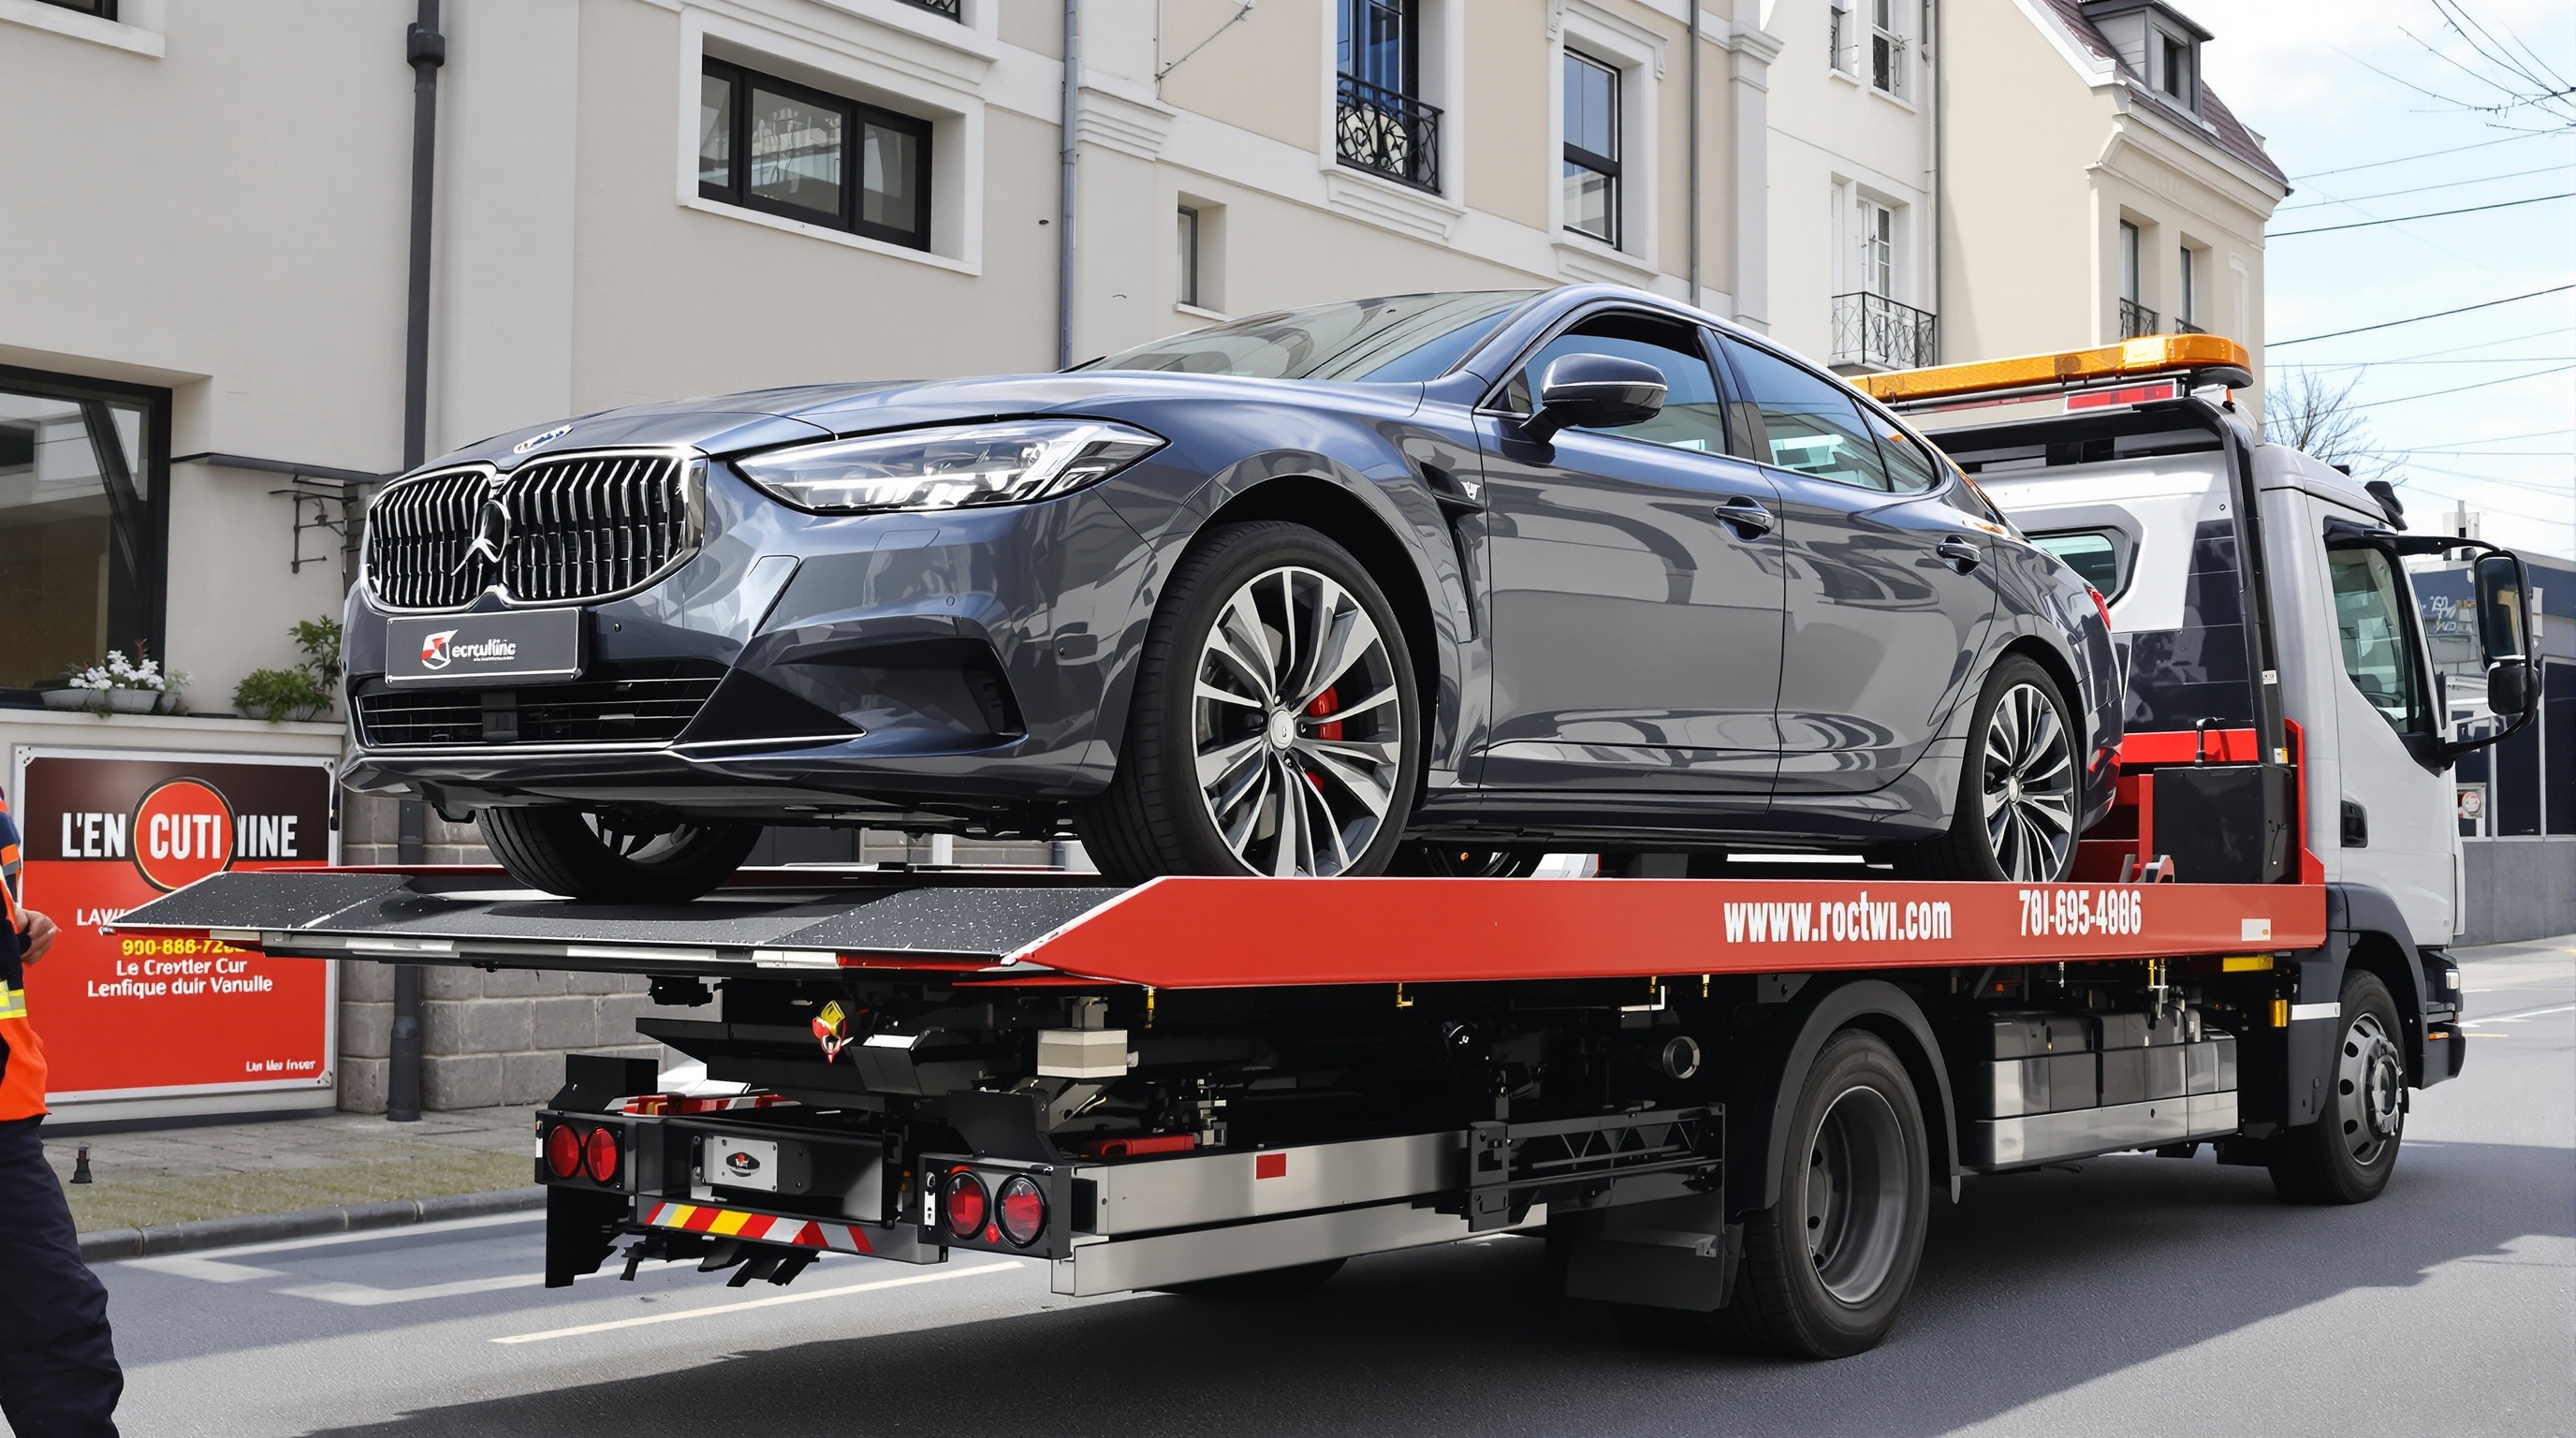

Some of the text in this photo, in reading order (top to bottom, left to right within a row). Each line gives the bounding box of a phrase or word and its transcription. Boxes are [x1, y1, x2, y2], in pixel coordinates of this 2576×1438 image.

[62, 813, 126, 858] L'EN
[150, 813, 222, 859] CUTI
[116, 960, 139, 976] Le
[215, 958, 247, 974] Cur
[88, 979, 167, 999] Lenfique
